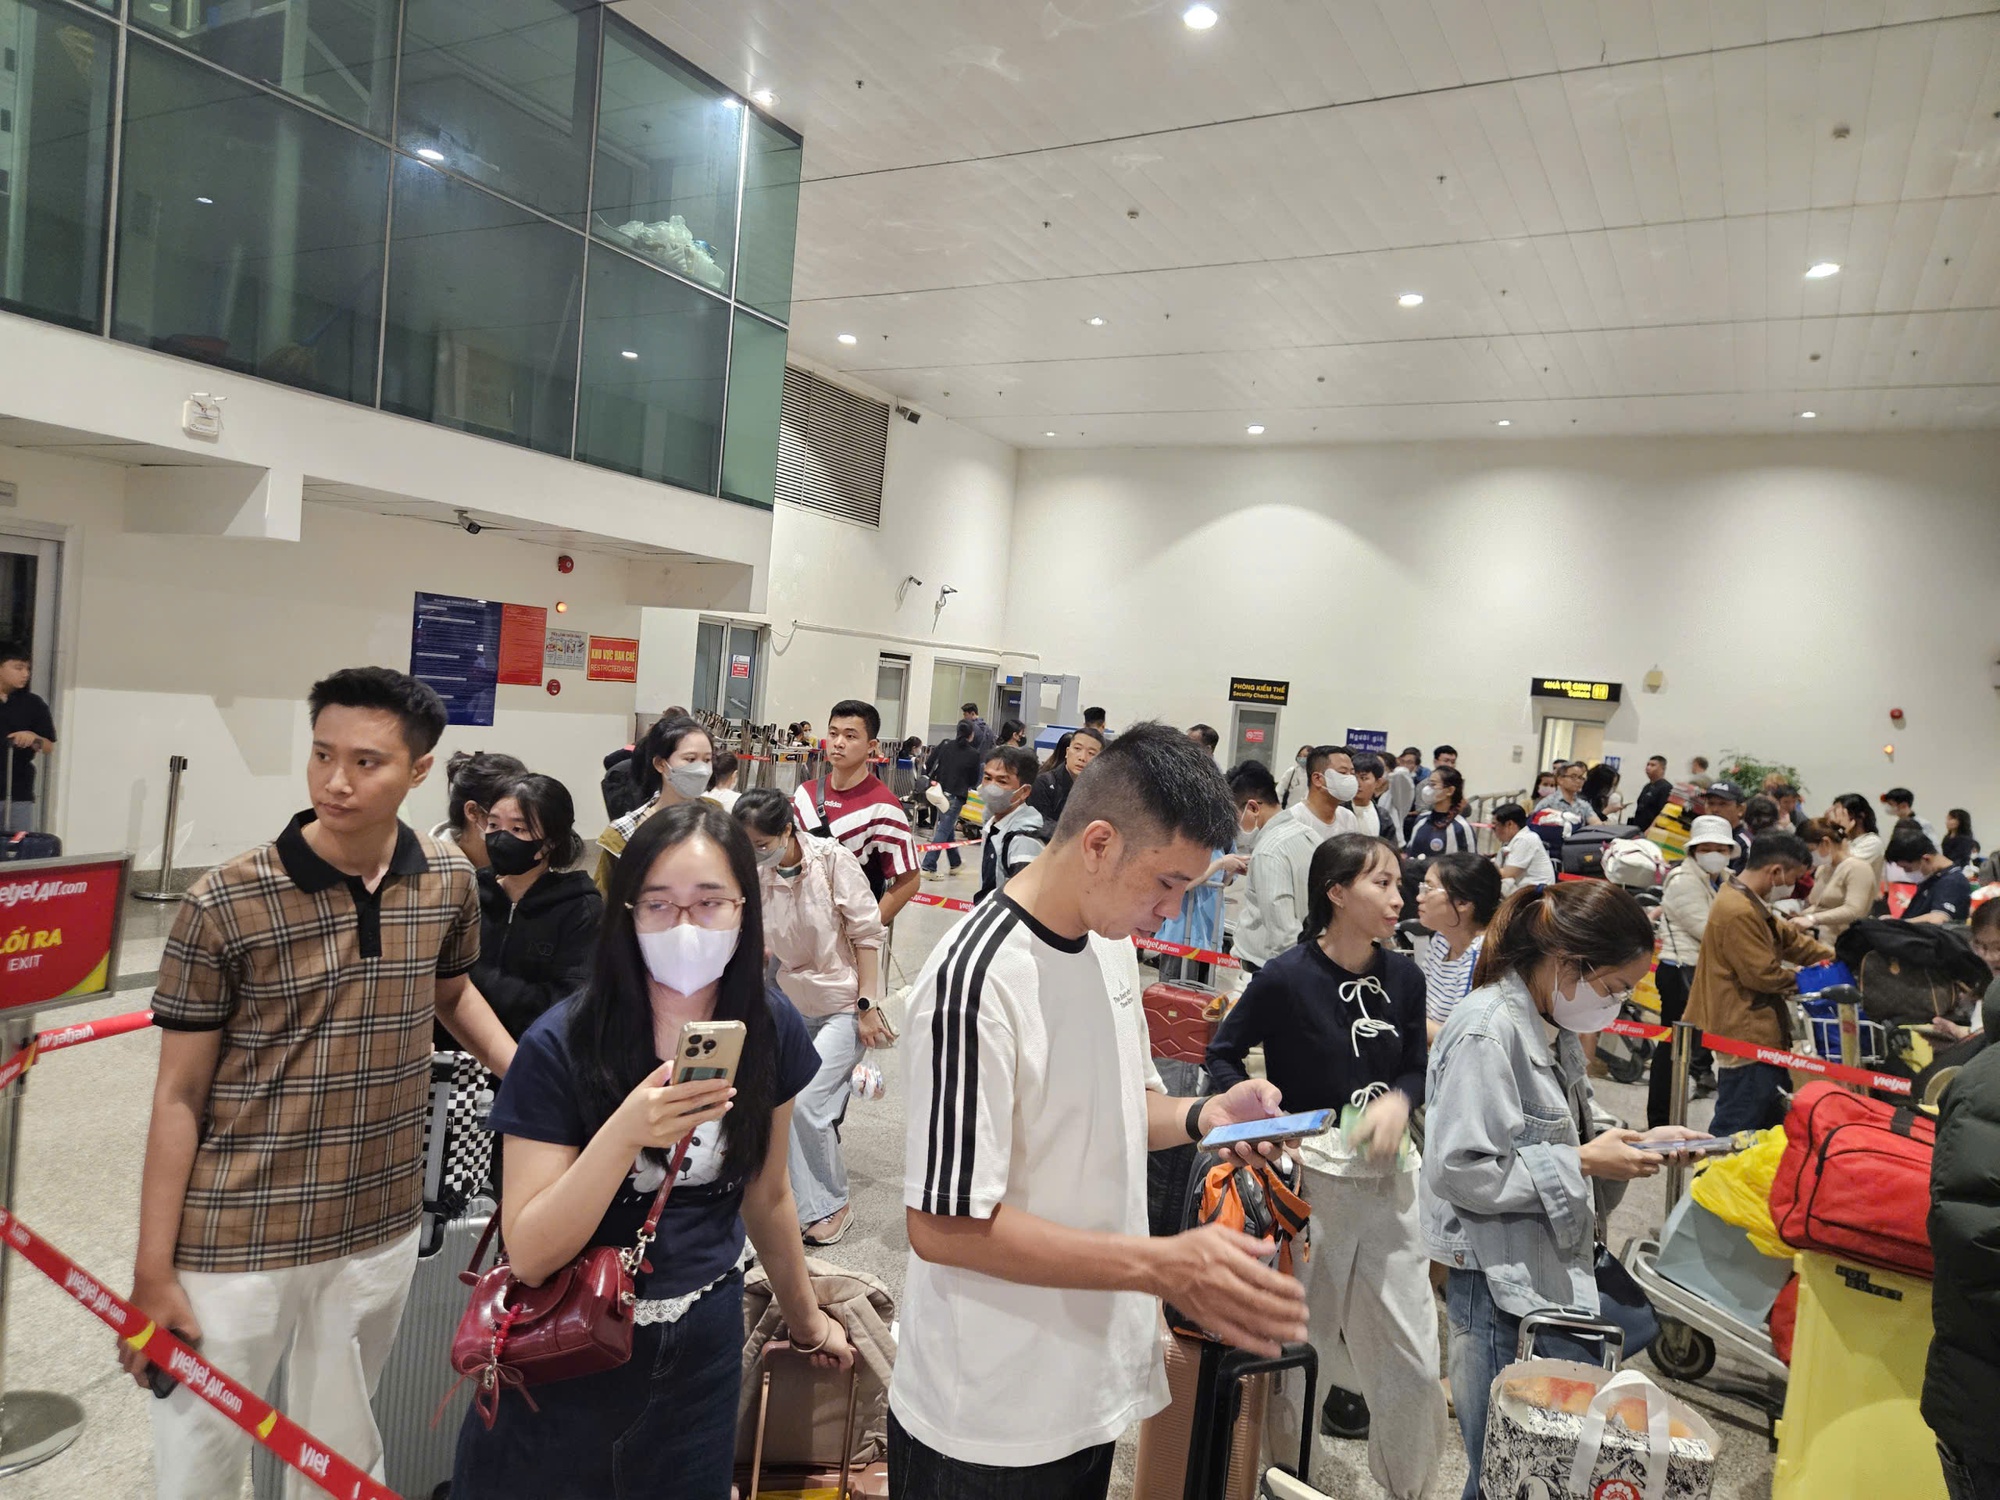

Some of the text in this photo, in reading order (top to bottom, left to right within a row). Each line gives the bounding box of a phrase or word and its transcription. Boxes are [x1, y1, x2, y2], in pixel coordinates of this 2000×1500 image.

[590, 664, 620, 673] RESTRICTED
[1232, 691, 1252, 699] Security
[824, 800, 843, 808] adidas
[0, 880, 88, 907] etjetAir.com
[31, 928, 63, 949] RA
[7, 954, 44, 972] EXIT
